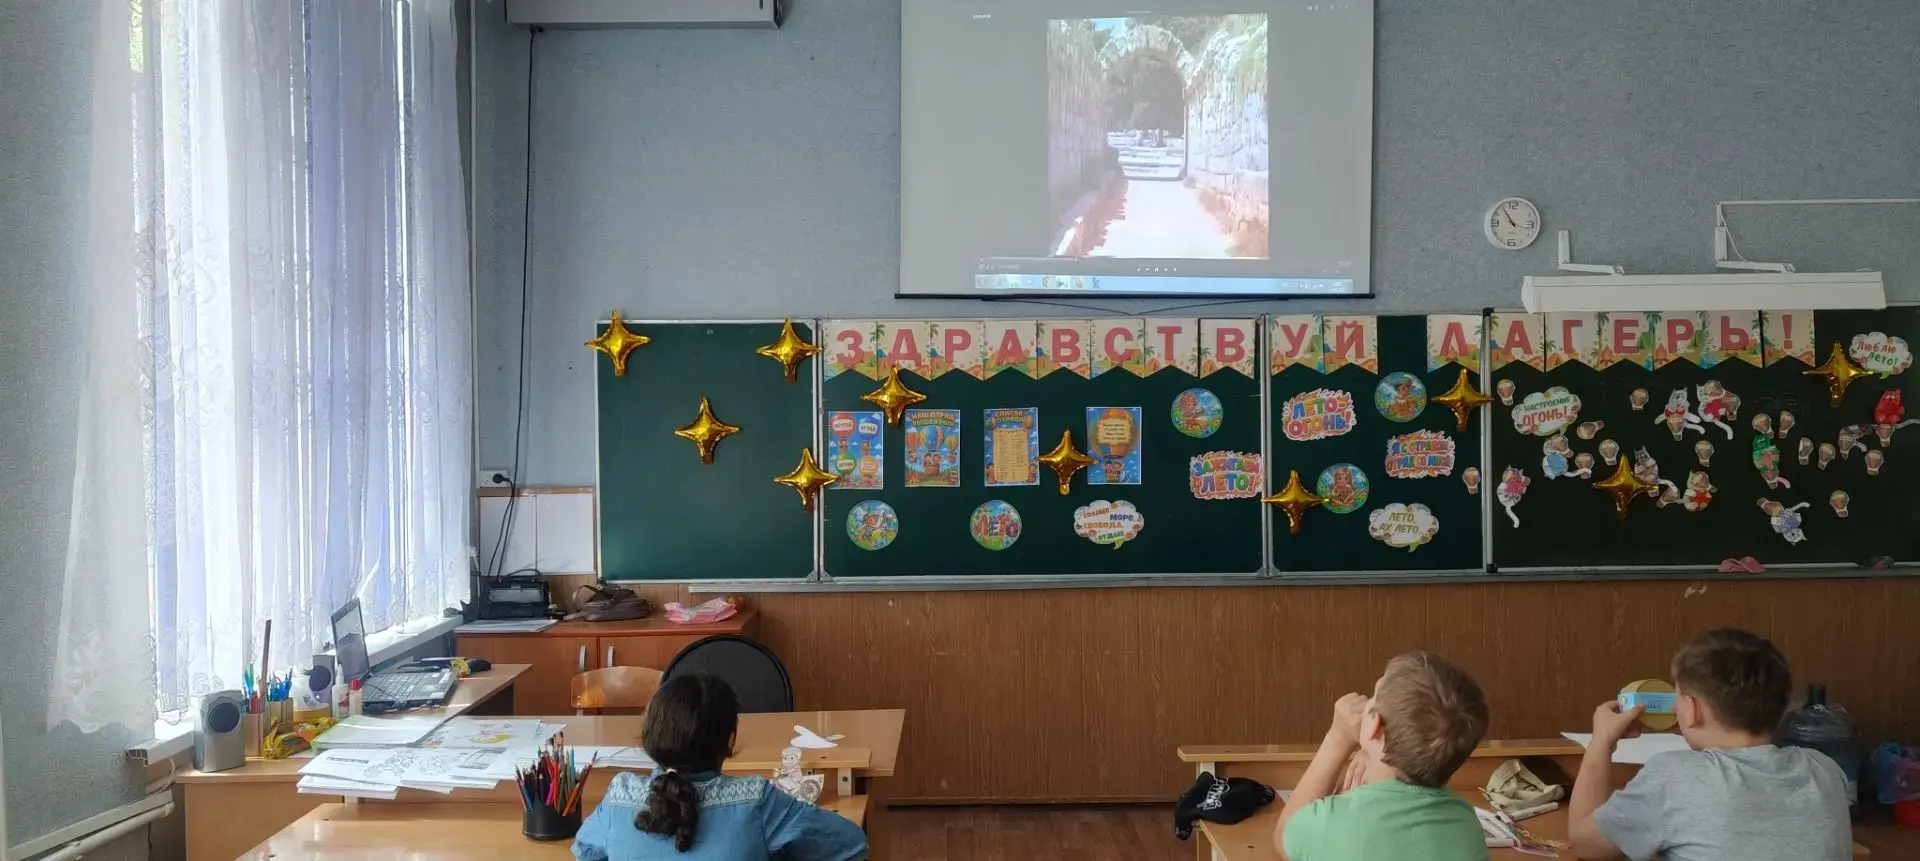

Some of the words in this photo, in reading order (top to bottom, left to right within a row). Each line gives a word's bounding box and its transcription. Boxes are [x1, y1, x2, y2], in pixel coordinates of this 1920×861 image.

[1508, 201, 1519, 210] 12
[1525, 219, 1535, 229] 3
[1506, 238, 1516, 247] 6
[837, 320, 1365, 366] ЗДРАВСТВУЙ
[1440, 315, 1794, 357] ЛАГЕРЬ!
[1524, 396, 1571, 412] НАСТРОЕНИЕ
[995, 410, 1023, 418] СПИСОК
[1522, 405, 1568, 430] ОГОНЬ!
[1288, 411, 1352, 437] ОГОНЬ!
[1193, 458, 1260, 477] ЗАЖИГАЕМ
[1201, 473, 1256, 493] ЛЕТО!
[974, 514, 1019, 537] ЛЕТО
